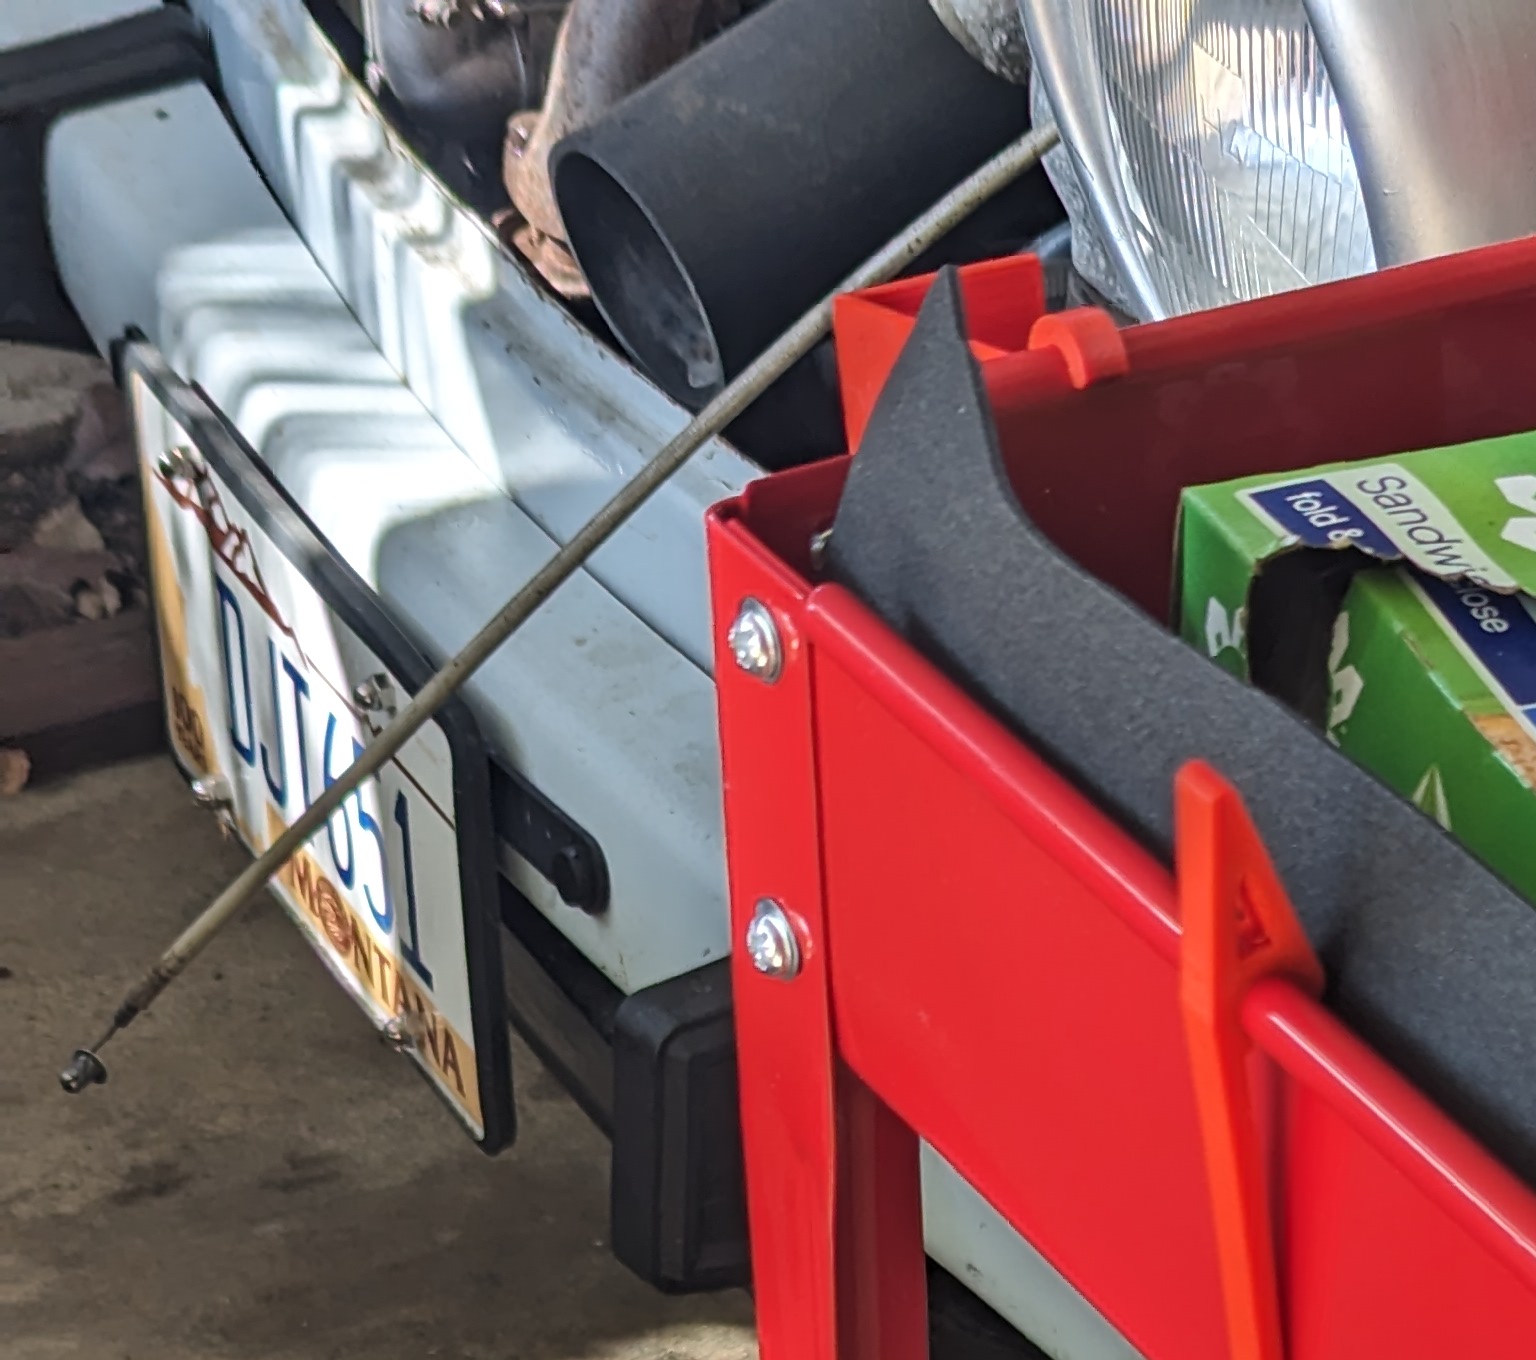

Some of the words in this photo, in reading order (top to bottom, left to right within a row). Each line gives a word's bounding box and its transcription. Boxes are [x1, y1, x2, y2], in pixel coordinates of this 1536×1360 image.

[1285, 490, 1350, 529] fold
[1327, 527, 1364, 541] &
[1452, 582, 1510, 634] lose
[217, 575, 434, 992] DJT651
